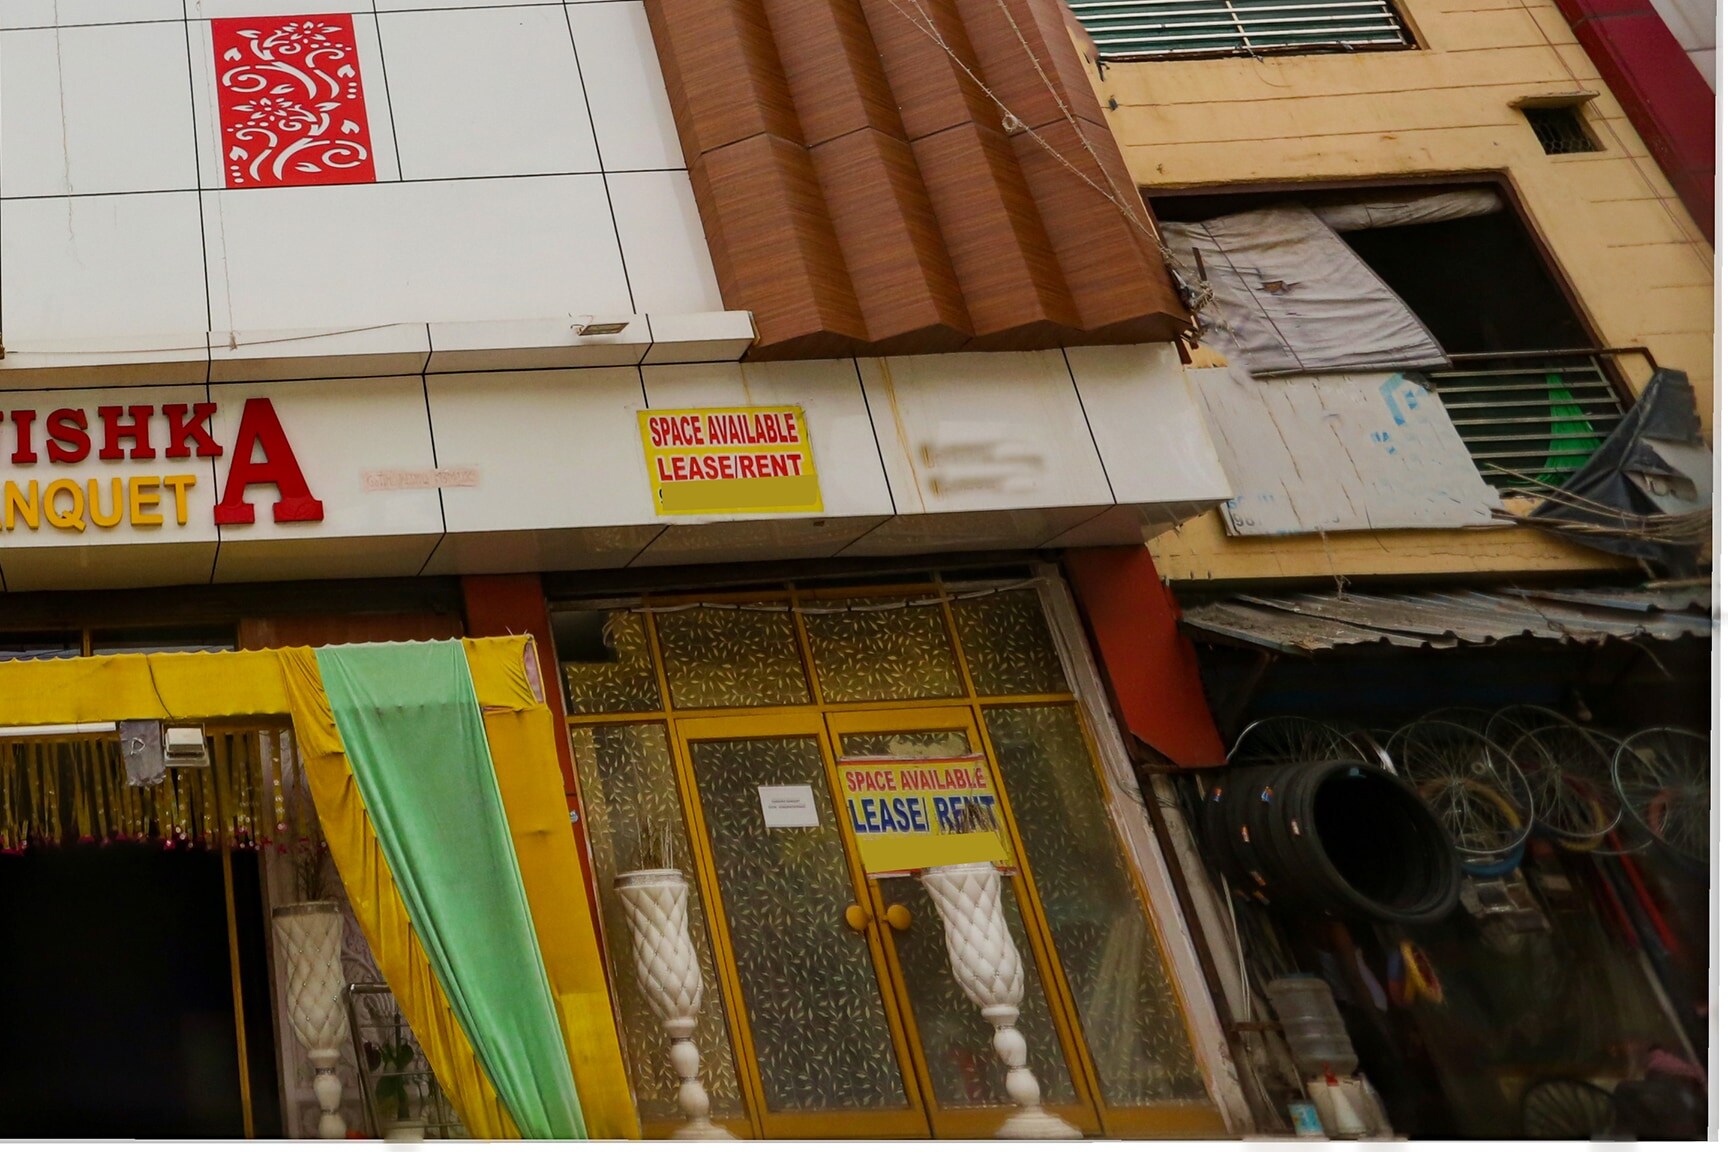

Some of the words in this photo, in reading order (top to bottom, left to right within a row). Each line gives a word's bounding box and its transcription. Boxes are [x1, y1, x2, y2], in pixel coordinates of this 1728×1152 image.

[649, 415, 704, 447] SPACE
[708, 413, 799, 445] AVAILABLE
[657, 453, 802, 481] LEASE/RENT
[845, 770, 897, 792] SPACE
[901, 767, 988, 791] AVAILABLE
[933, 795, 995, 834] RENT
